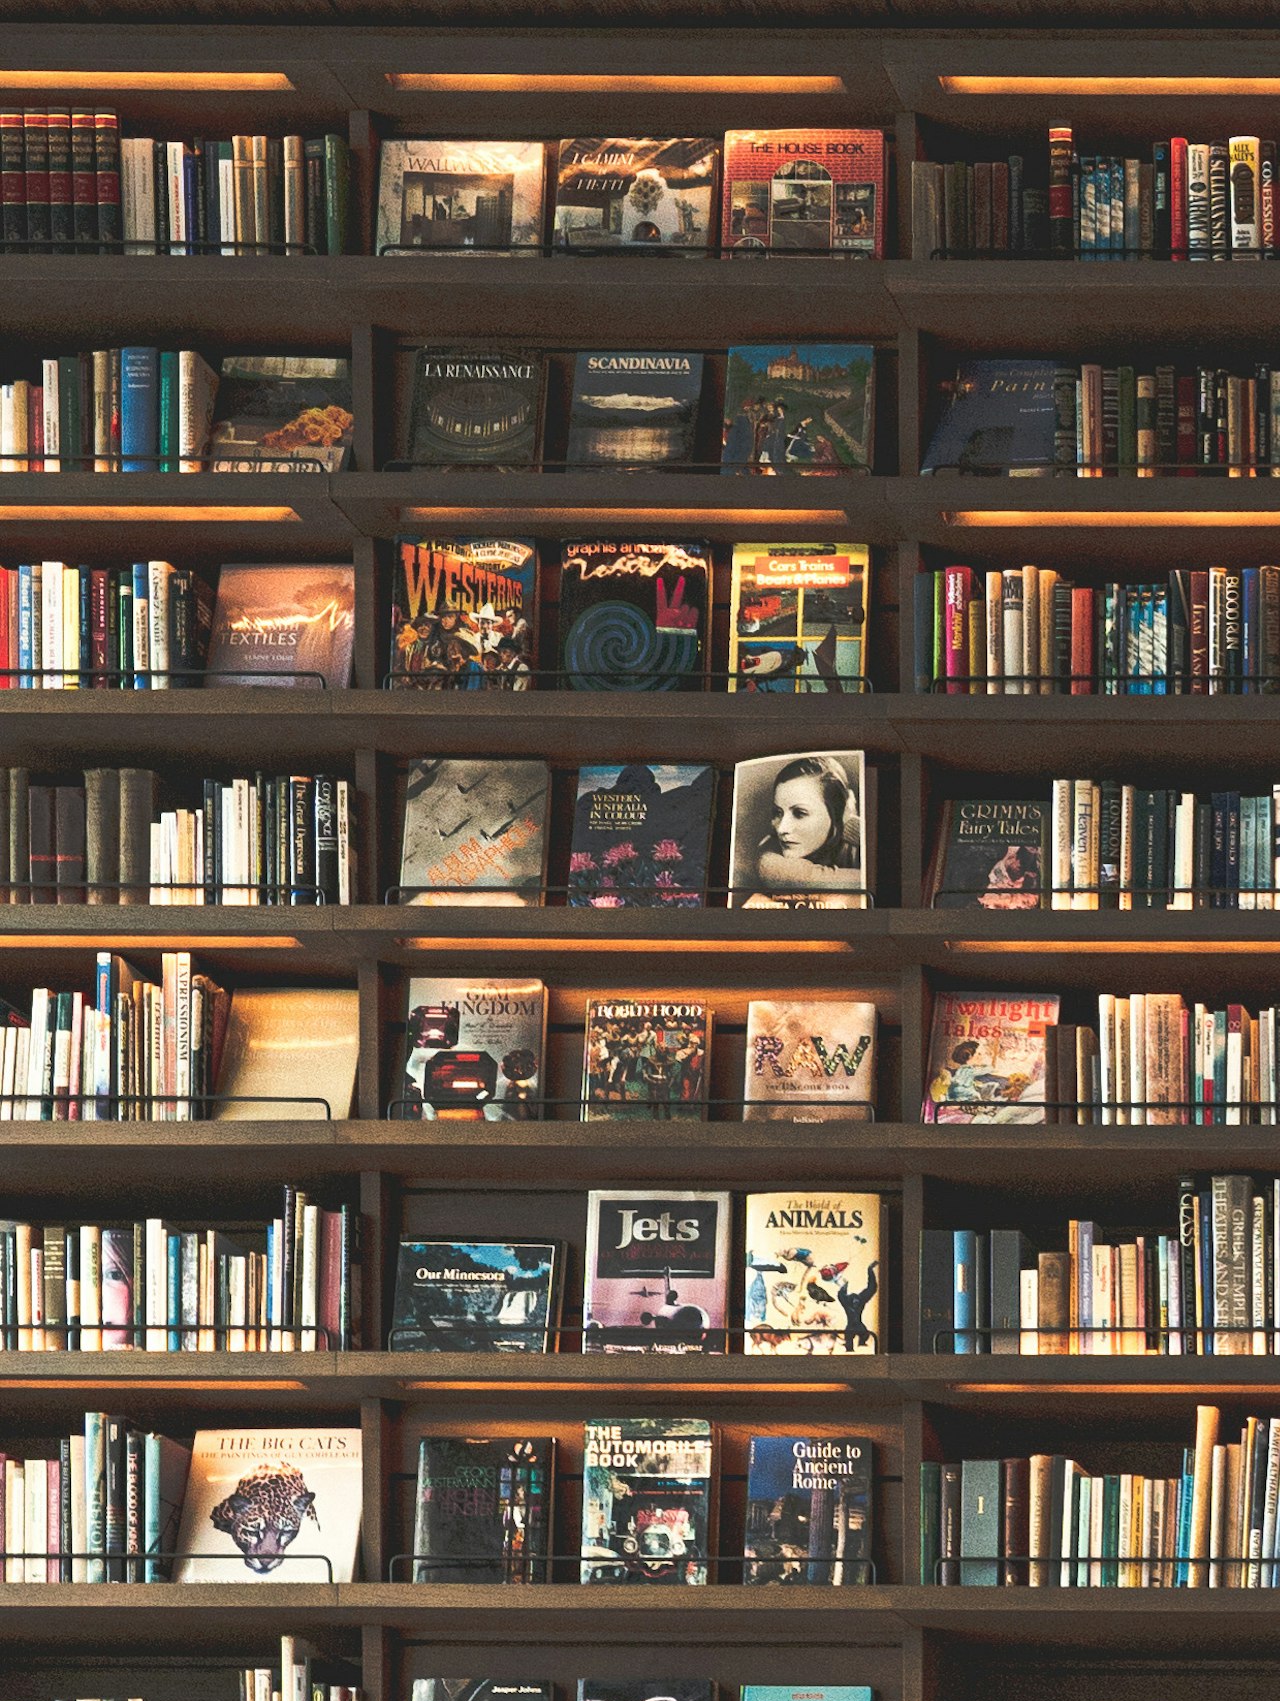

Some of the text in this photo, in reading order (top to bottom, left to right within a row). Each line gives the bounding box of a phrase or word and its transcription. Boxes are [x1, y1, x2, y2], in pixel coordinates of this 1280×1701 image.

[749, 143, 865, 155] THE HOUSE BOOK
[587, 356, 691, 370] SCANDINAVIA
[424, 363, 534, 380] LA RENAISSANCE
[960, 804, 1041, 820] GRIMM'S
[959, 821, 1040, 839] Fairy Tales
[753, 1036, 871, 1078] RAW
[765, 1210, 863, 1229] ANIMALS
[616, 1210, 708, 1254] Jets
[416, 1269, 506, 1281] Our Minnesota
[586, 1426, 621, 1440] THE
[219, 1435, 347, 1450] THE BIG CATS
[586, 1440, 711, 1454] AUTOMOBILE
[792, 1442, 861, 1459] Guide to
[586, 1454, 639, 1468] BOOK
[792, 1458, 854, 1475] Ancient
[792, 1475, 837, 1491] Rome
